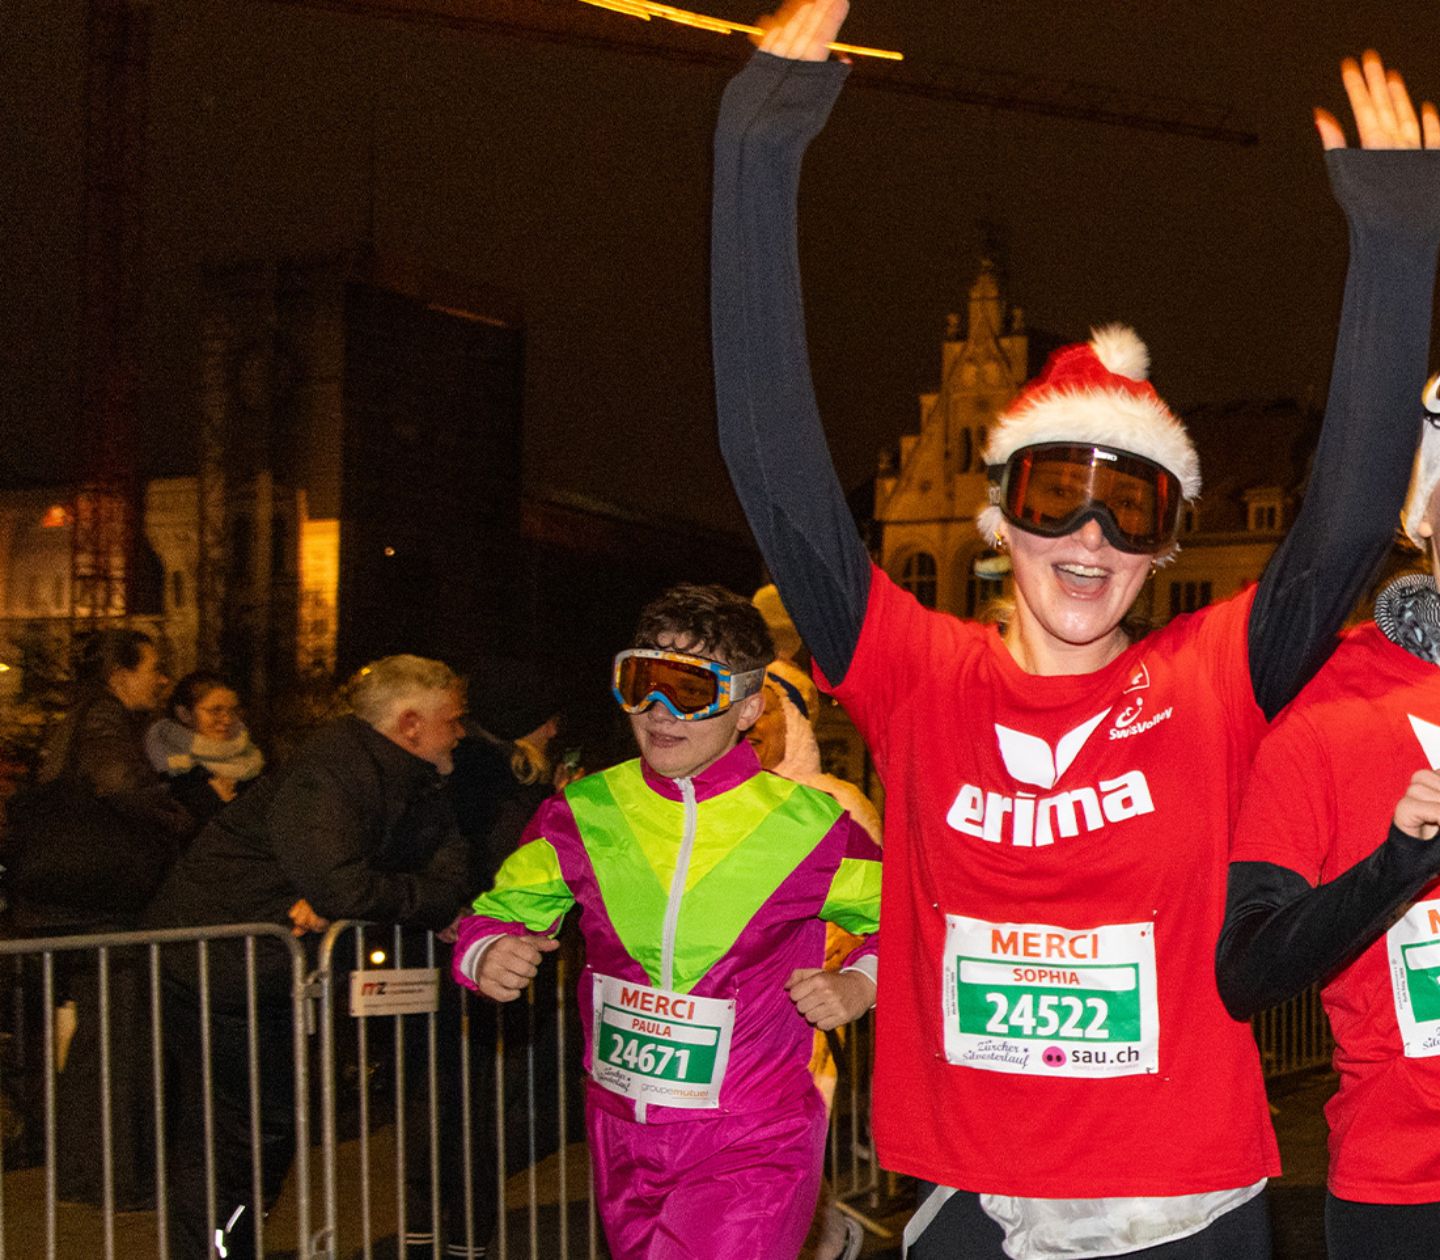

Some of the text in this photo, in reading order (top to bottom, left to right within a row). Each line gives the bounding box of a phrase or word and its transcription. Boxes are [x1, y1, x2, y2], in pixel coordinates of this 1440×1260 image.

[946, 770, 1155, 847] erima
[991, 929, 1098, 959] MERCI
[1012, 968, 1081, 985] SOPHIA
[620, 987, 695, 1020] MERCI
[985, 992, 1109, 1039] 24522
[632, 1018, 671, 1038] PAULA
[609, 1033, 690, 1079] 24671
[1071, 1046, 1139, 1064] sau.ch
